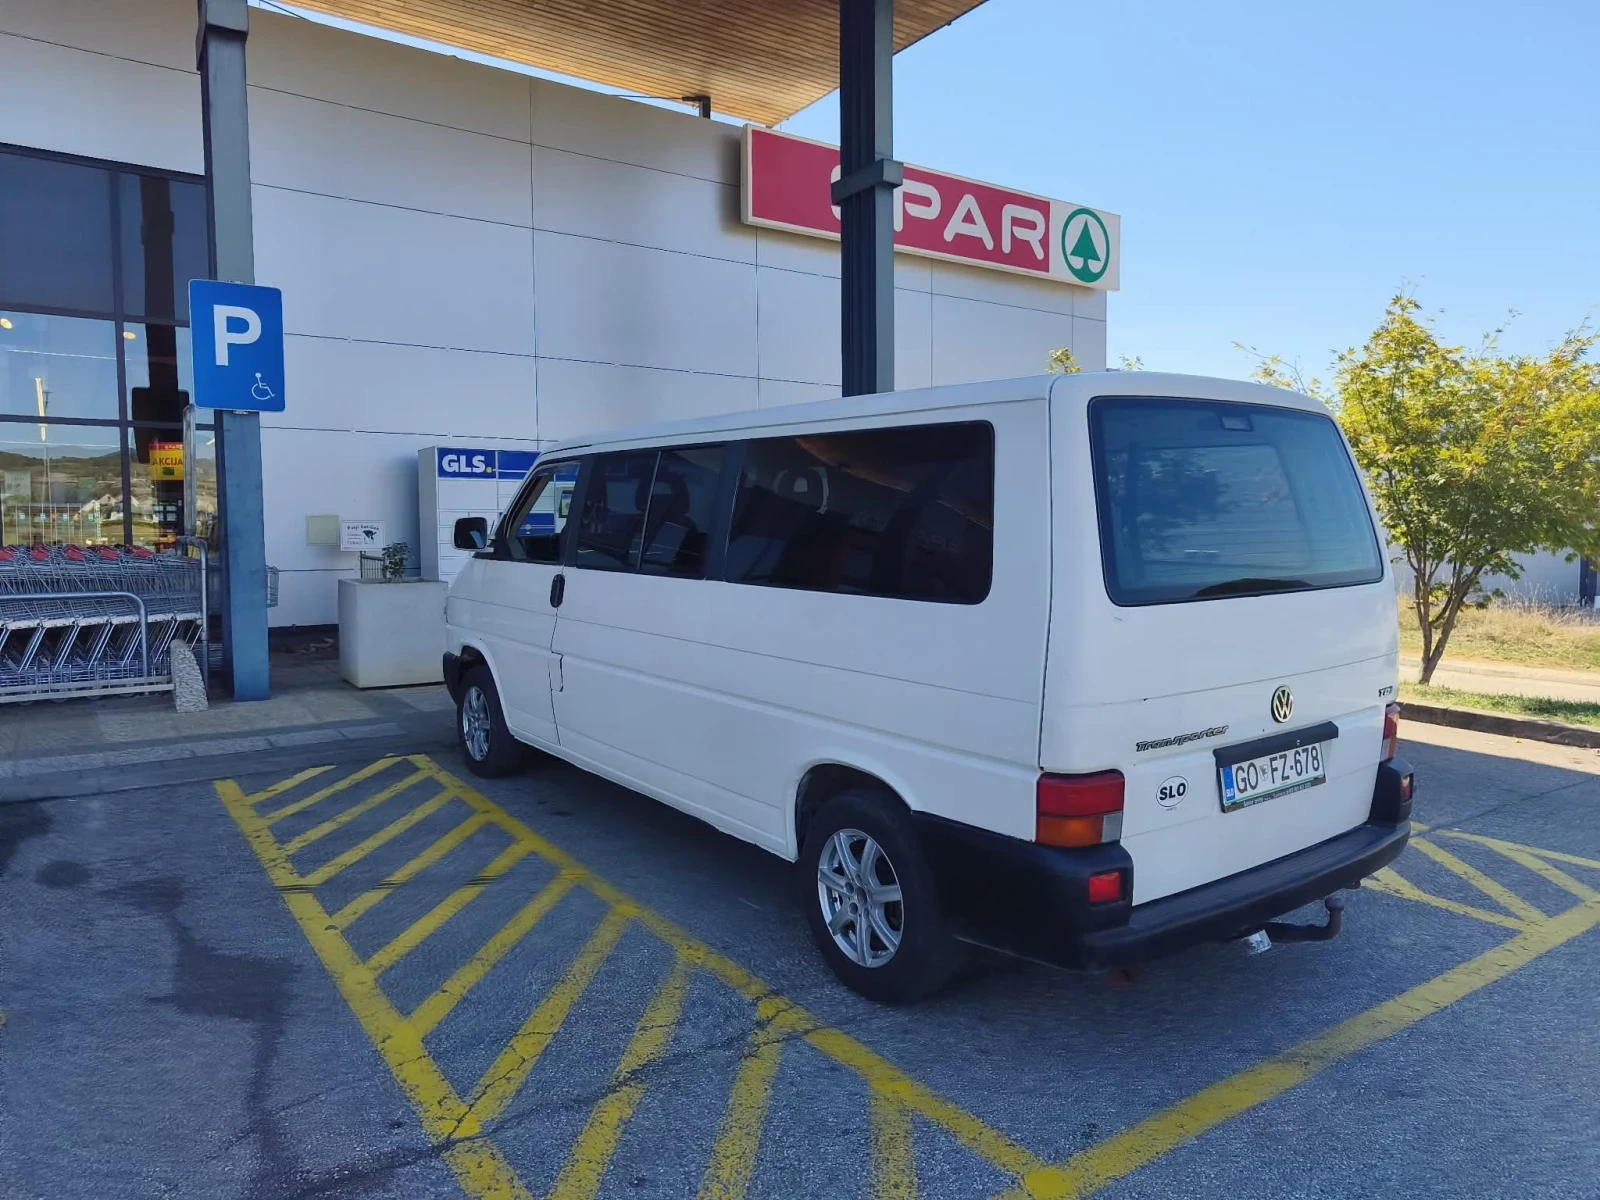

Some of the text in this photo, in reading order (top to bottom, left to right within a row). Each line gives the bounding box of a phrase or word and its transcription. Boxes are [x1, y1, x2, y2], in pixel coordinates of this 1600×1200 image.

[213, 304, 262, 366] P
[152, 457, 184, 466] AKCIJA
[1136, 725, 1229, 752] Transporter
[1235, 745, 1320, 794] GO FZ-678
[1159, 782, 1186, 801] SLO
